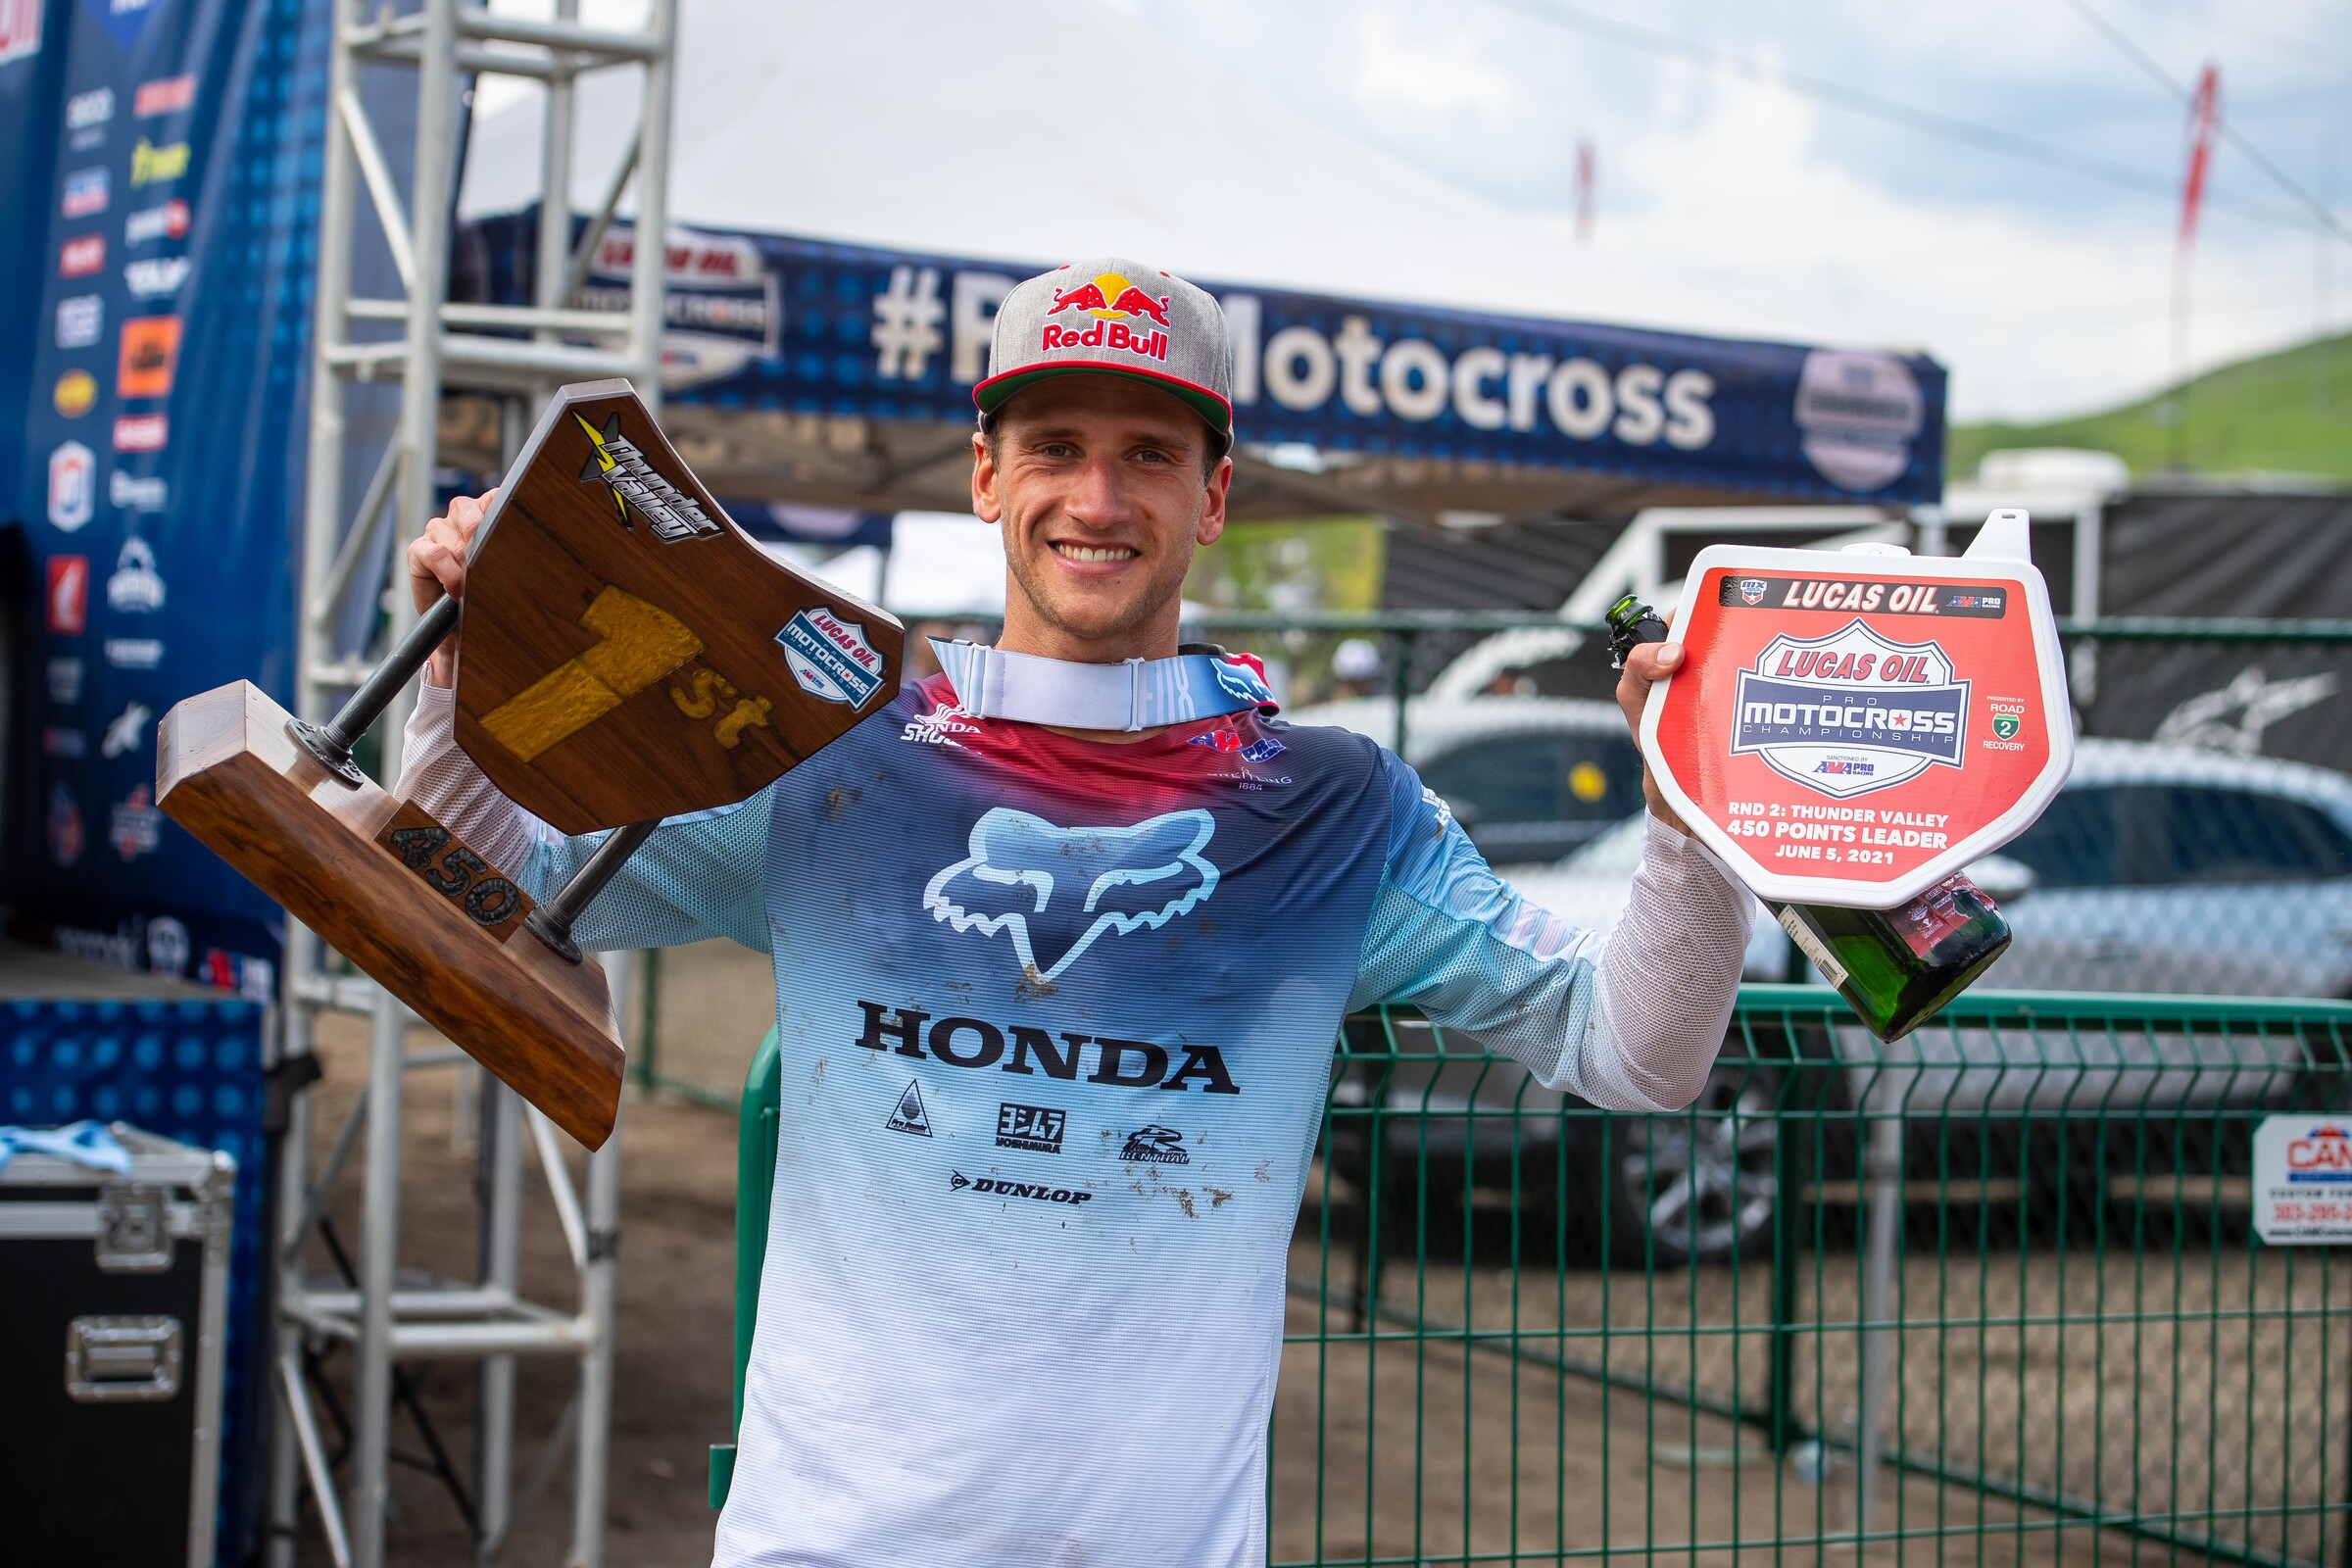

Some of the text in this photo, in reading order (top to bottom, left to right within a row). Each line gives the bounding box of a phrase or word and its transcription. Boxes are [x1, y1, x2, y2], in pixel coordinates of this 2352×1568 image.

[1042, 319, 1169, 364] Red Bull
[601, 434, 720, 531] Thunder
[602, 465, 692, 539] Valley
[1782, 580, 1938, 614] LUCAS OIL
[1946, 595, 1982, 608] AMA
[812, 614, 877, 668] LUCAS OIL
[786, 622, 870, 696] MOTOCROSS
[1775, 650, 1929, 683] LUCAS OIL
[1823, 695, 1878, 707] PRO
[1990, 703, 2026, 713] ROAD
[1743, 702, 1957, 733] MOTOCROSS
[1999, 720, 2012, 736] 2
[1742, 724, 1954, 744] CHAMPIONSHIP
[1983, 740, 2025, 752] RECOVERY
[1812, 760, 1852, 775] AMA
[1239, 782, 1263, 791] 1884
[1728, 802, 1949, 828] RND 2: THUNDER VALLEY
[1727, 819, 1948, 850] 450 POINTS LEADER
[1775, 844, 1894, 864] JUNE 5, 2021
[391, 827, 521, 926] 450
[855, 1000, 1241, 1095] HONDA
[995, 1136, 1062, 1154] YOSHIMURA
[1119, 1151, 1190, 1164] RENTHAL
[972, 1177, 1092, 1205] DUNLOP
